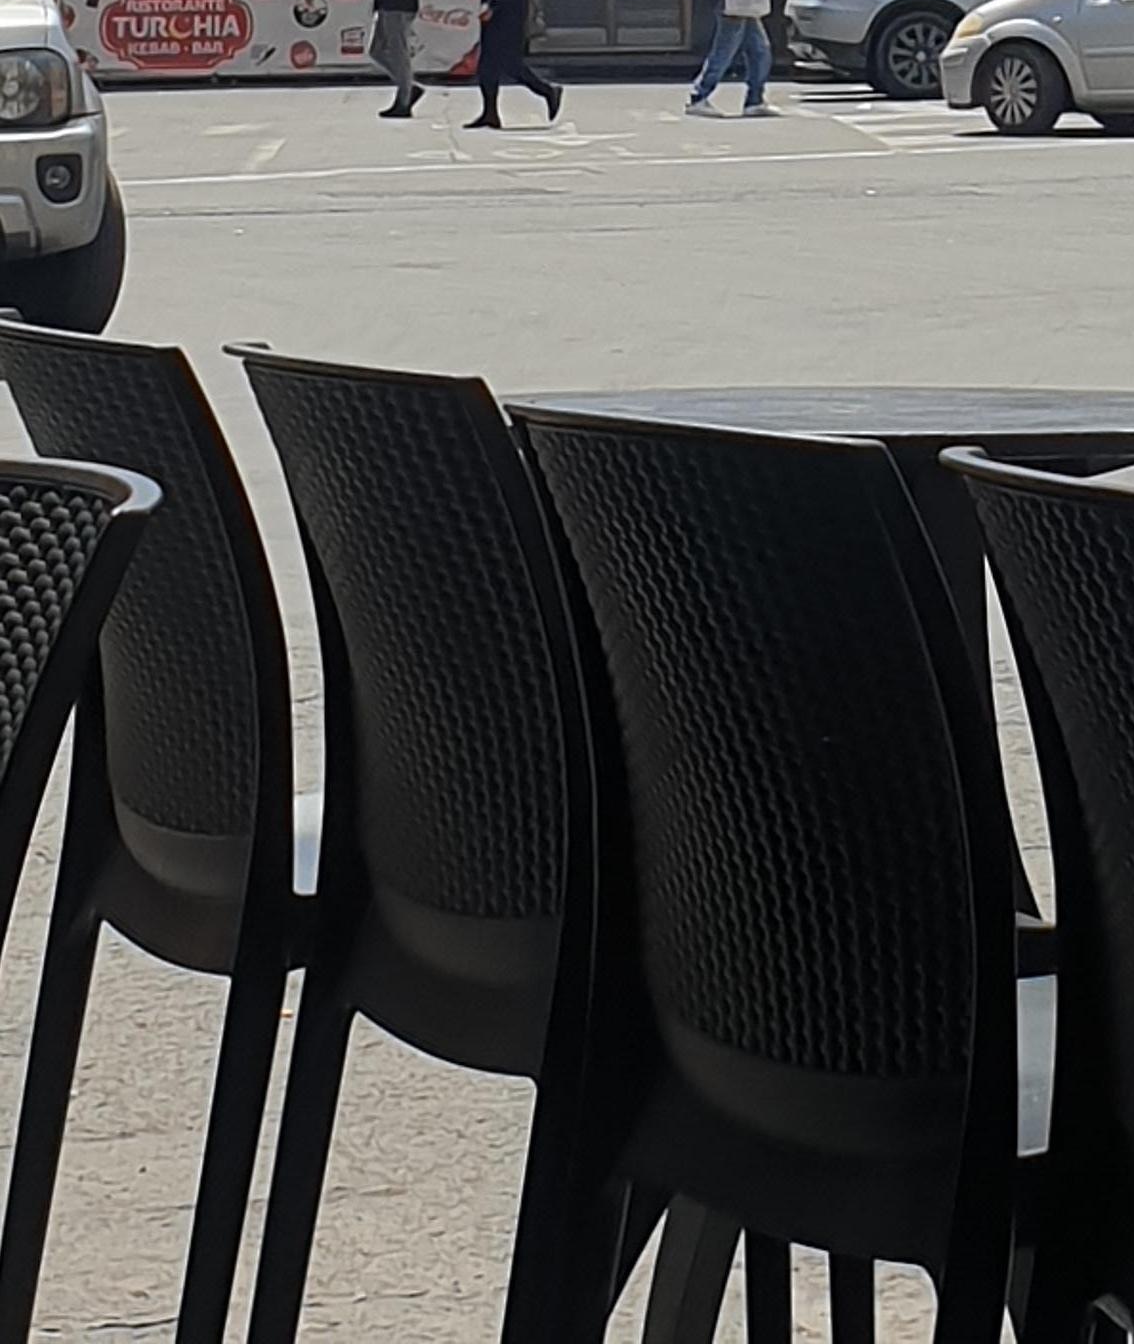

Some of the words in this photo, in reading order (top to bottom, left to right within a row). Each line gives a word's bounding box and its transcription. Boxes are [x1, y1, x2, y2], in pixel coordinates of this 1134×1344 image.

[111, 14, 241, 40] TURCHIA
[128, 41, 181, 55] KEBAB
[191, 41, 224, 55] BAR
